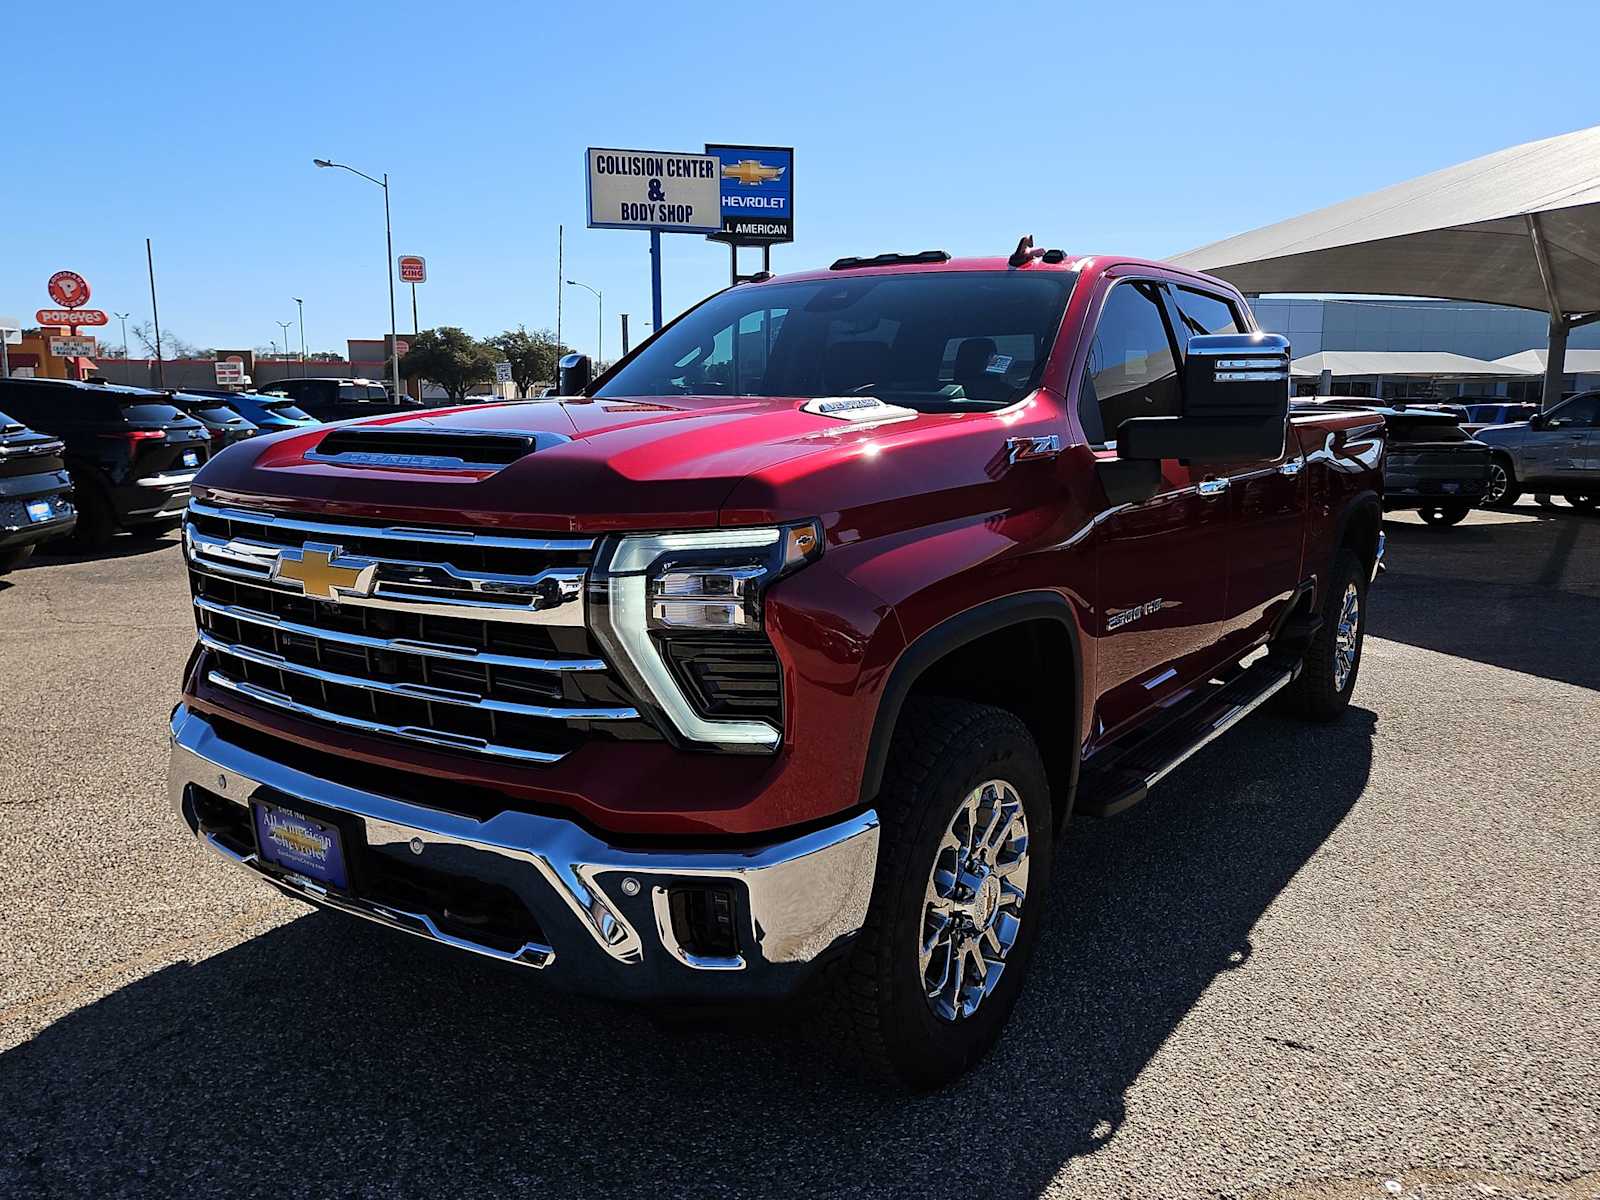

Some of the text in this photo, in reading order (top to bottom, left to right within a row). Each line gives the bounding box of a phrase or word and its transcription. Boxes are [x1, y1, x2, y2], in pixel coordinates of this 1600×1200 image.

[596, 155, 715, 180] COLLISION CENTER
[647, 178, 666, 202] &
[721, 195, 786, 209] HEVROLET
[621, 203, 694, 224] BODY SHOP
[735, 223, 788, 235] AMERICAN
[498, 373, 511, 381] 35
[350, 453, 443, 465] CHEVROLET
[1106, 605, 1143, 632] 2500
[263, 813, 332, 849] All American
